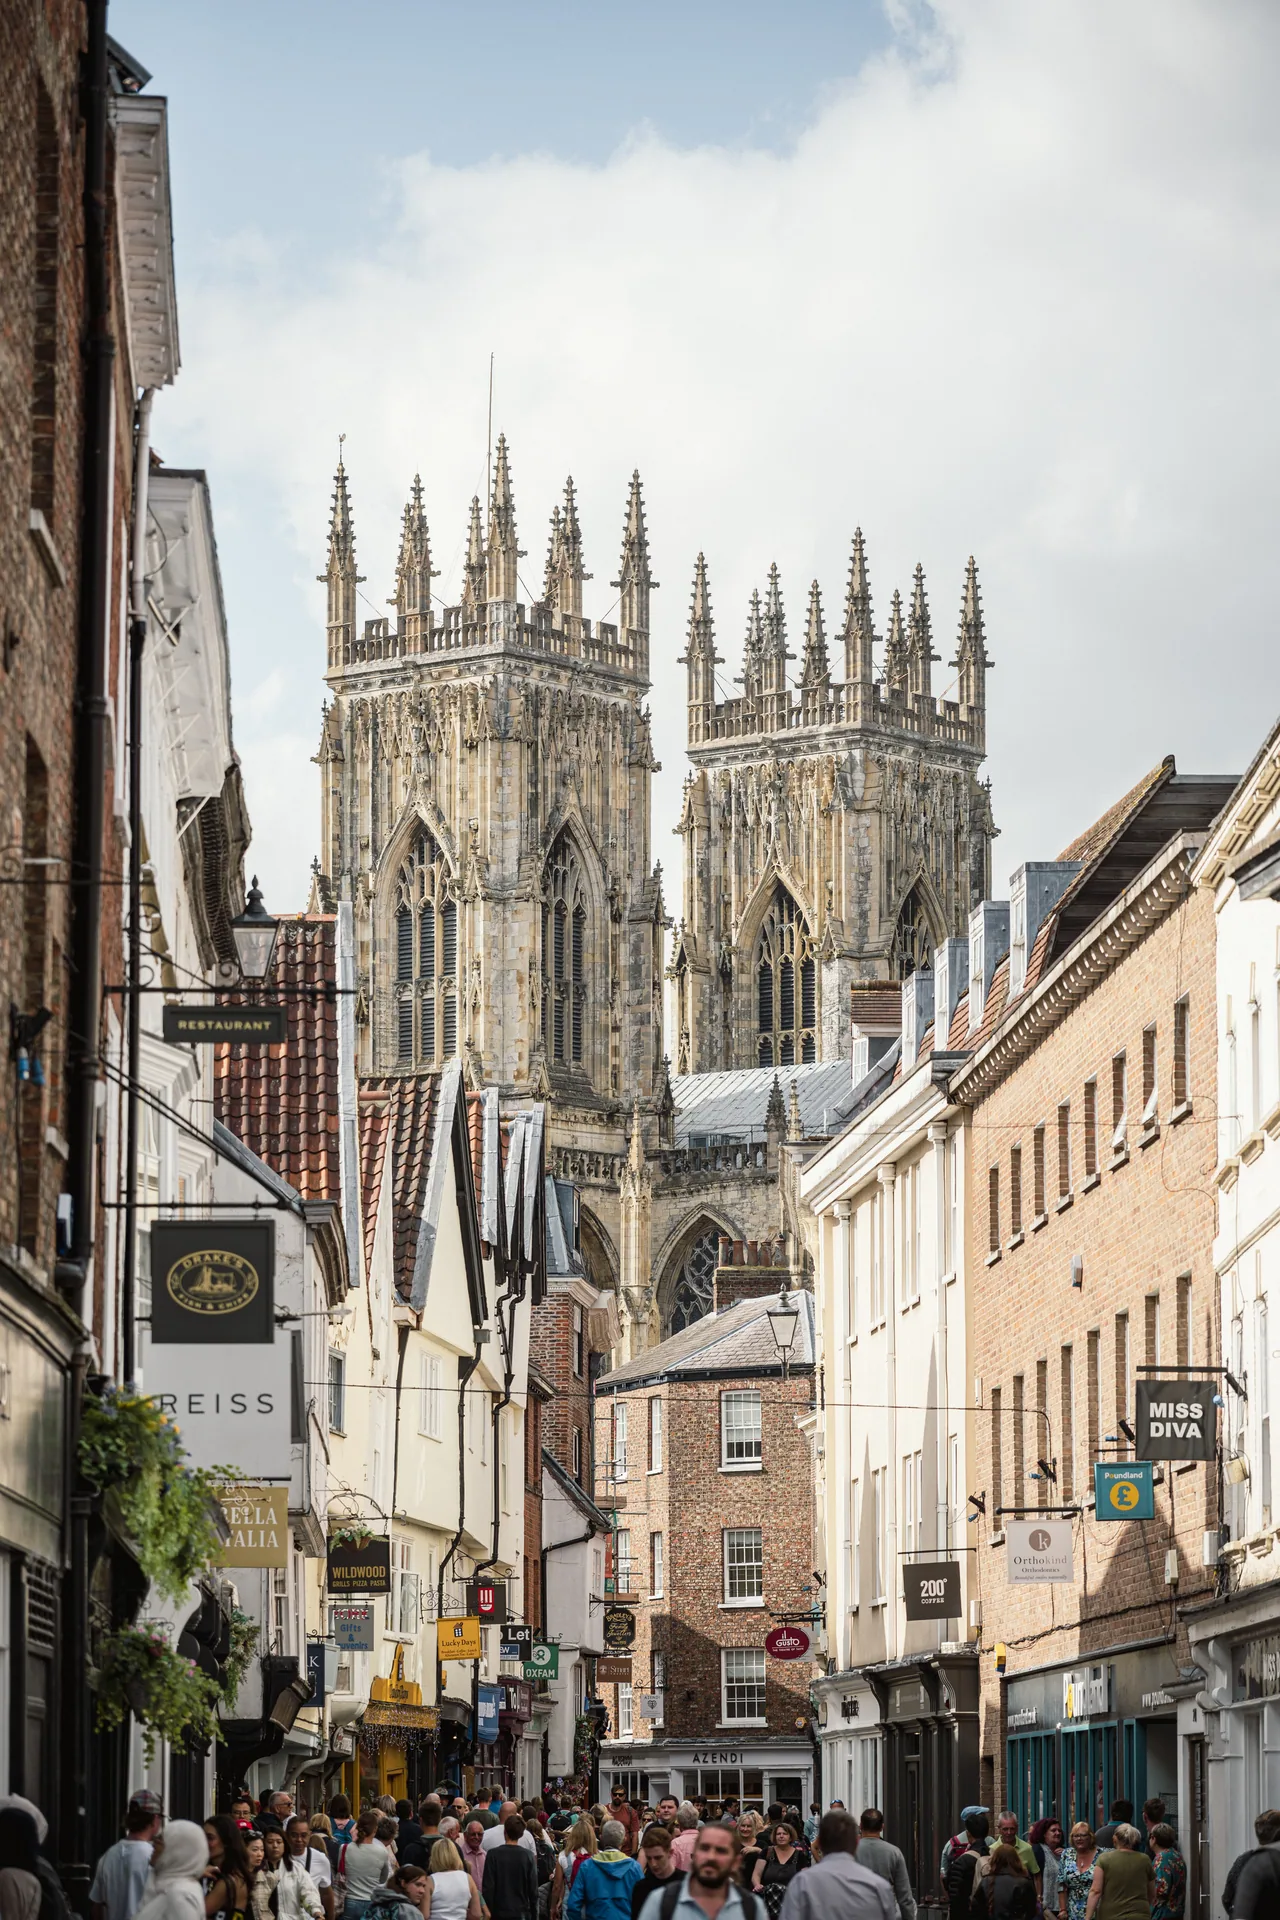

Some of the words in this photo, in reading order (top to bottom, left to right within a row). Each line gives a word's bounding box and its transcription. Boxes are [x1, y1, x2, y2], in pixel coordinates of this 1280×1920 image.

[178, 1021, 271, 1030] RESTAURANT
[182, 1253, 244, 1269] DRAKE'S
[160, 1393, 274, 1414] REISS
[1149, 1402, 1204, 1419] MISS
[1150, 1421, 1202, 1438] DIVA
[1104, 1471, 1143, 1479] Poundland
[1013, 1555, 1067, 1565] Orthokind
[332, 1566, 386, 1579] WILDWOOD
[340, 1624, 361, 1632] Gifts
[348, 1633, 354, 1642] &
[508, 1628, 531, 1641] Let
[441, 1639, 460, 1647] Lucky
[461, 1639, 476, 1647] Days
[525, 1669, 555, 1678] OXFAM
[692, 1753, 743, 1764] AZENDI
